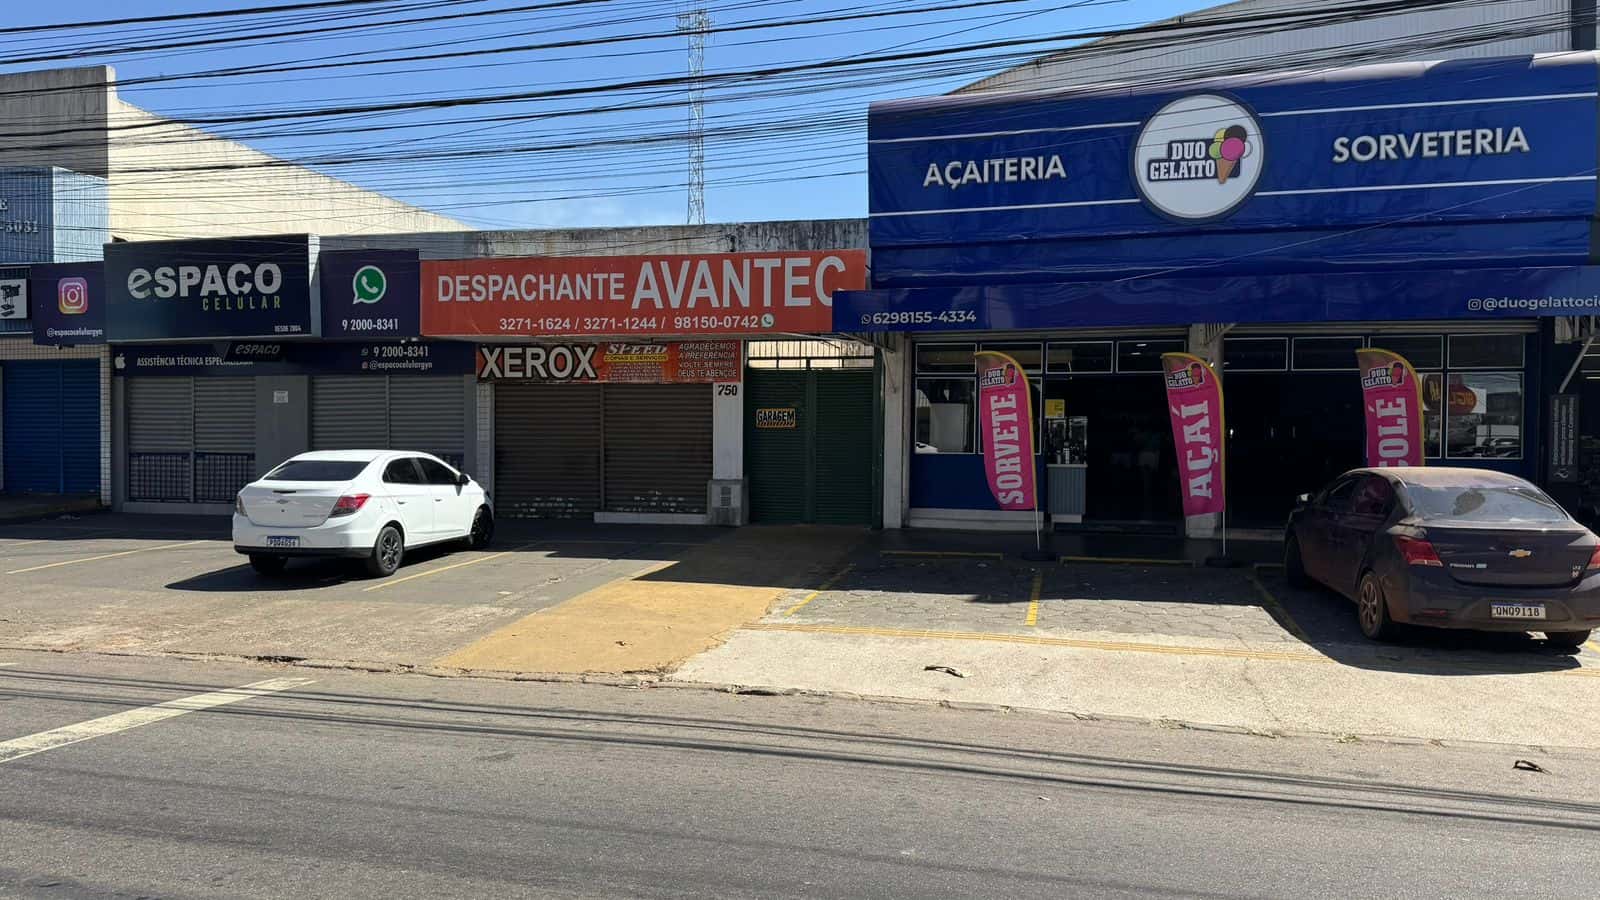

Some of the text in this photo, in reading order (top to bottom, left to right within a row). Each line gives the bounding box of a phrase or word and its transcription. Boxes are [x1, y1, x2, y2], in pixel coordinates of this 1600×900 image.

[1171, 141, 1206, 160] DUO
[1332, 126, 1530, 163] SORVETERIA
[922, 154, 1067, 190] AÇAITERIA
[1149, 160, 1215, 180] GELATTO
[437, 255, 846, 309] DESPACHANTE AVANTEC
[202, 296, 281, 311] CELULAR
[1482, 295, 1600, 311] @duogelattoci
[342, 318, 399, 331] 9 2000-8341
[499, 317, 571, 331] 3271-1624
[583, 316, 657, 330] 3271-1244
[674, 315, 759, 329] 98150-0742
[872, 309, 977, 325] 6298155-4334
[373, 346, 429, 357] 9 2000-8341
[177, 354, 204, 366] TÉCNICA
[480, 345, 597, 379] XEROX
[717, 384, 738, 396] 750
[756, 410, 795, 423] GARAGEM
[990, 393, 1025, 505] SORVETE
[1171, 400, 1219, 499] AÇAÍ
